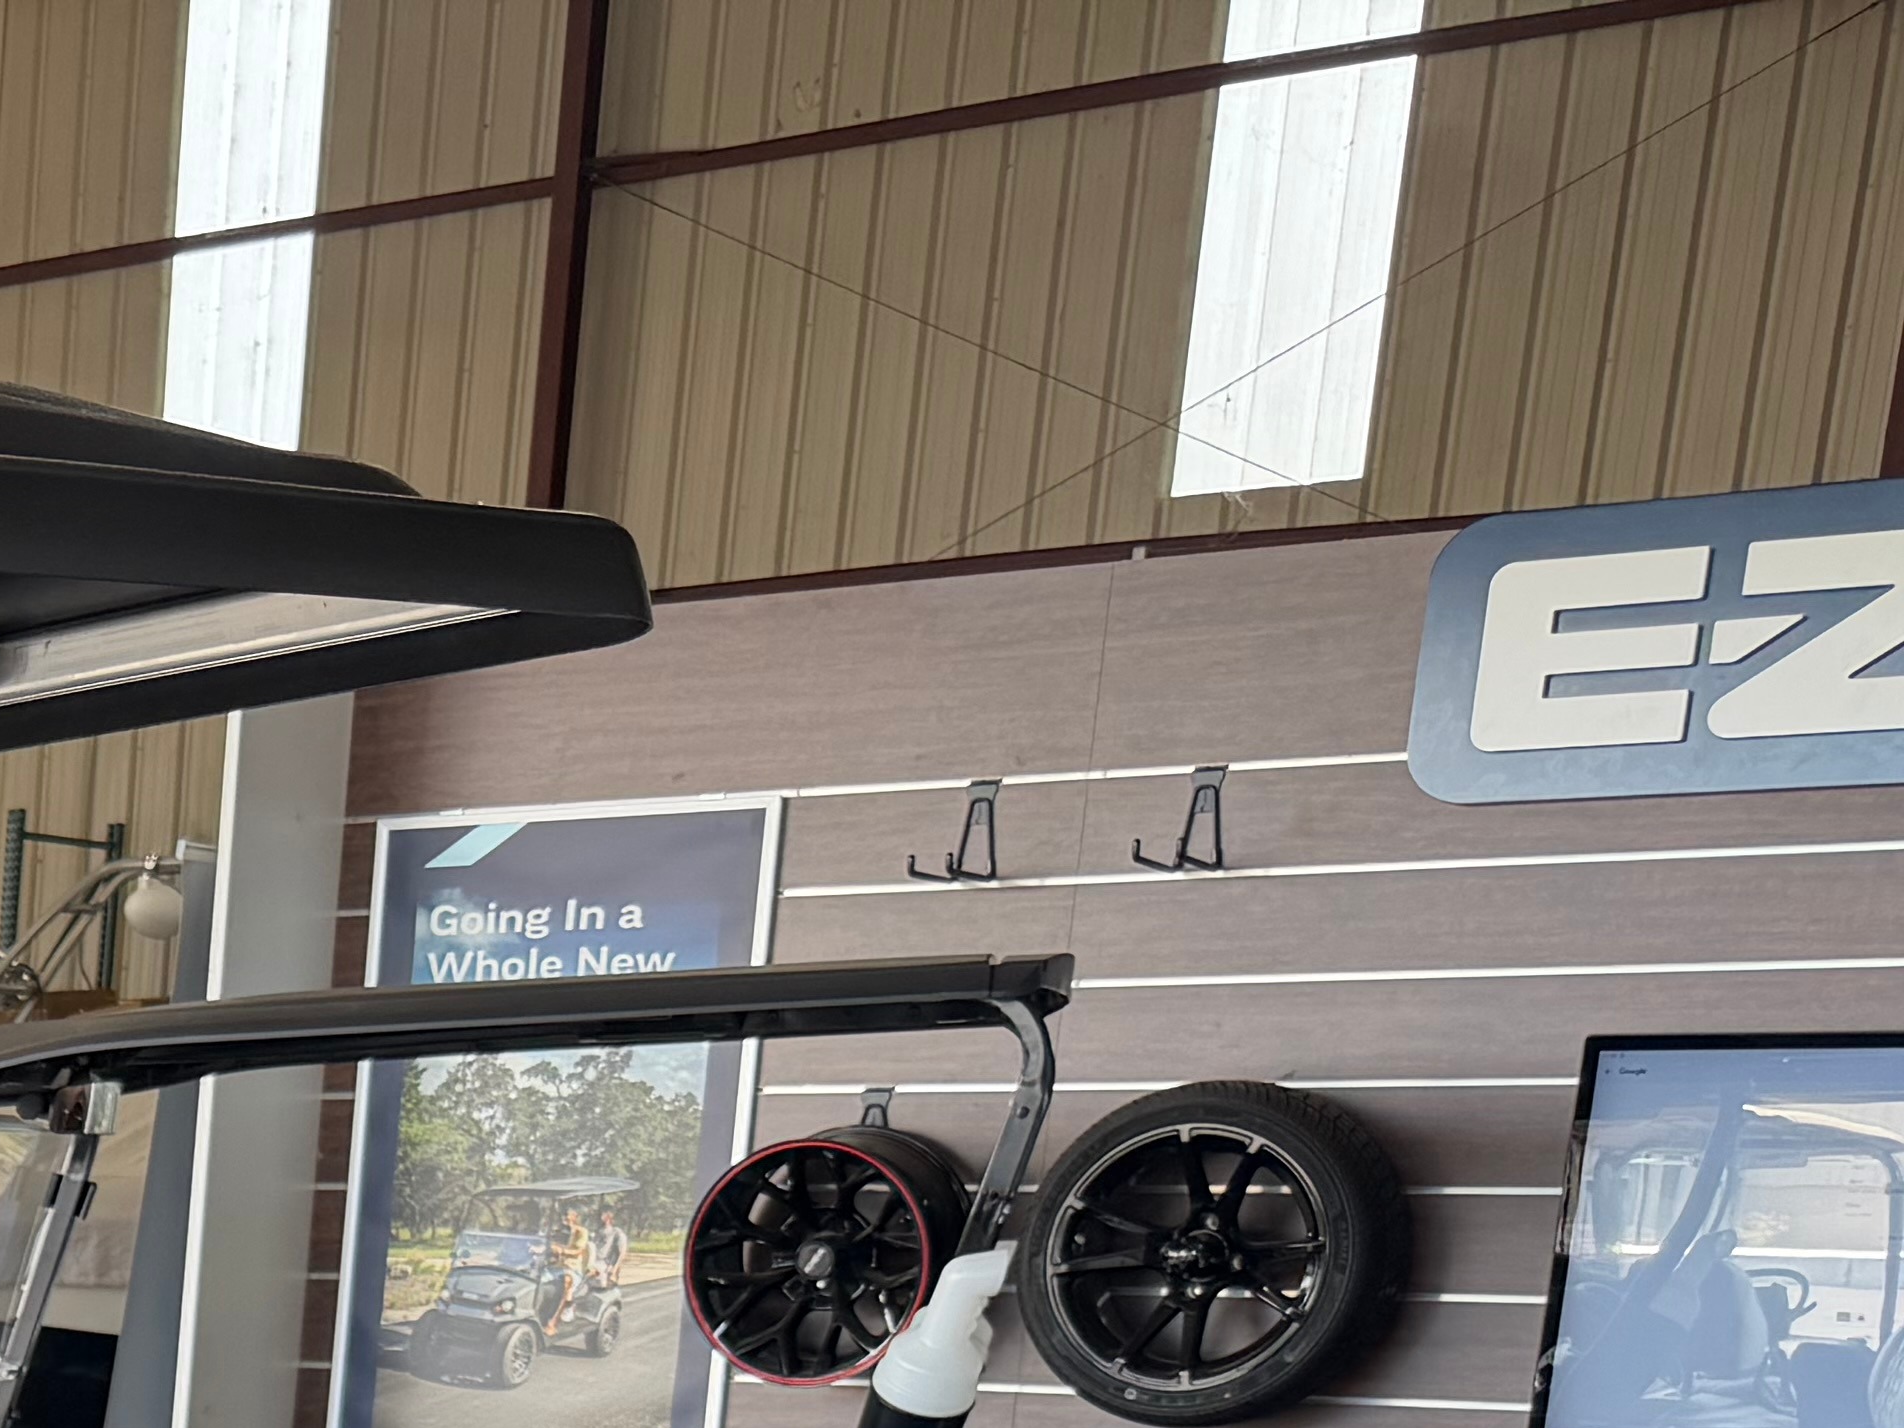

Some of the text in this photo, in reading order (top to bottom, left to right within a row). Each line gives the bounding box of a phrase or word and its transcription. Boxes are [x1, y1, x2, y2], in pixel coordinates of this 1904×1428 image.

[430, 898, 644, 939] Going In a
[427, 946, 677, 983] Whole New
